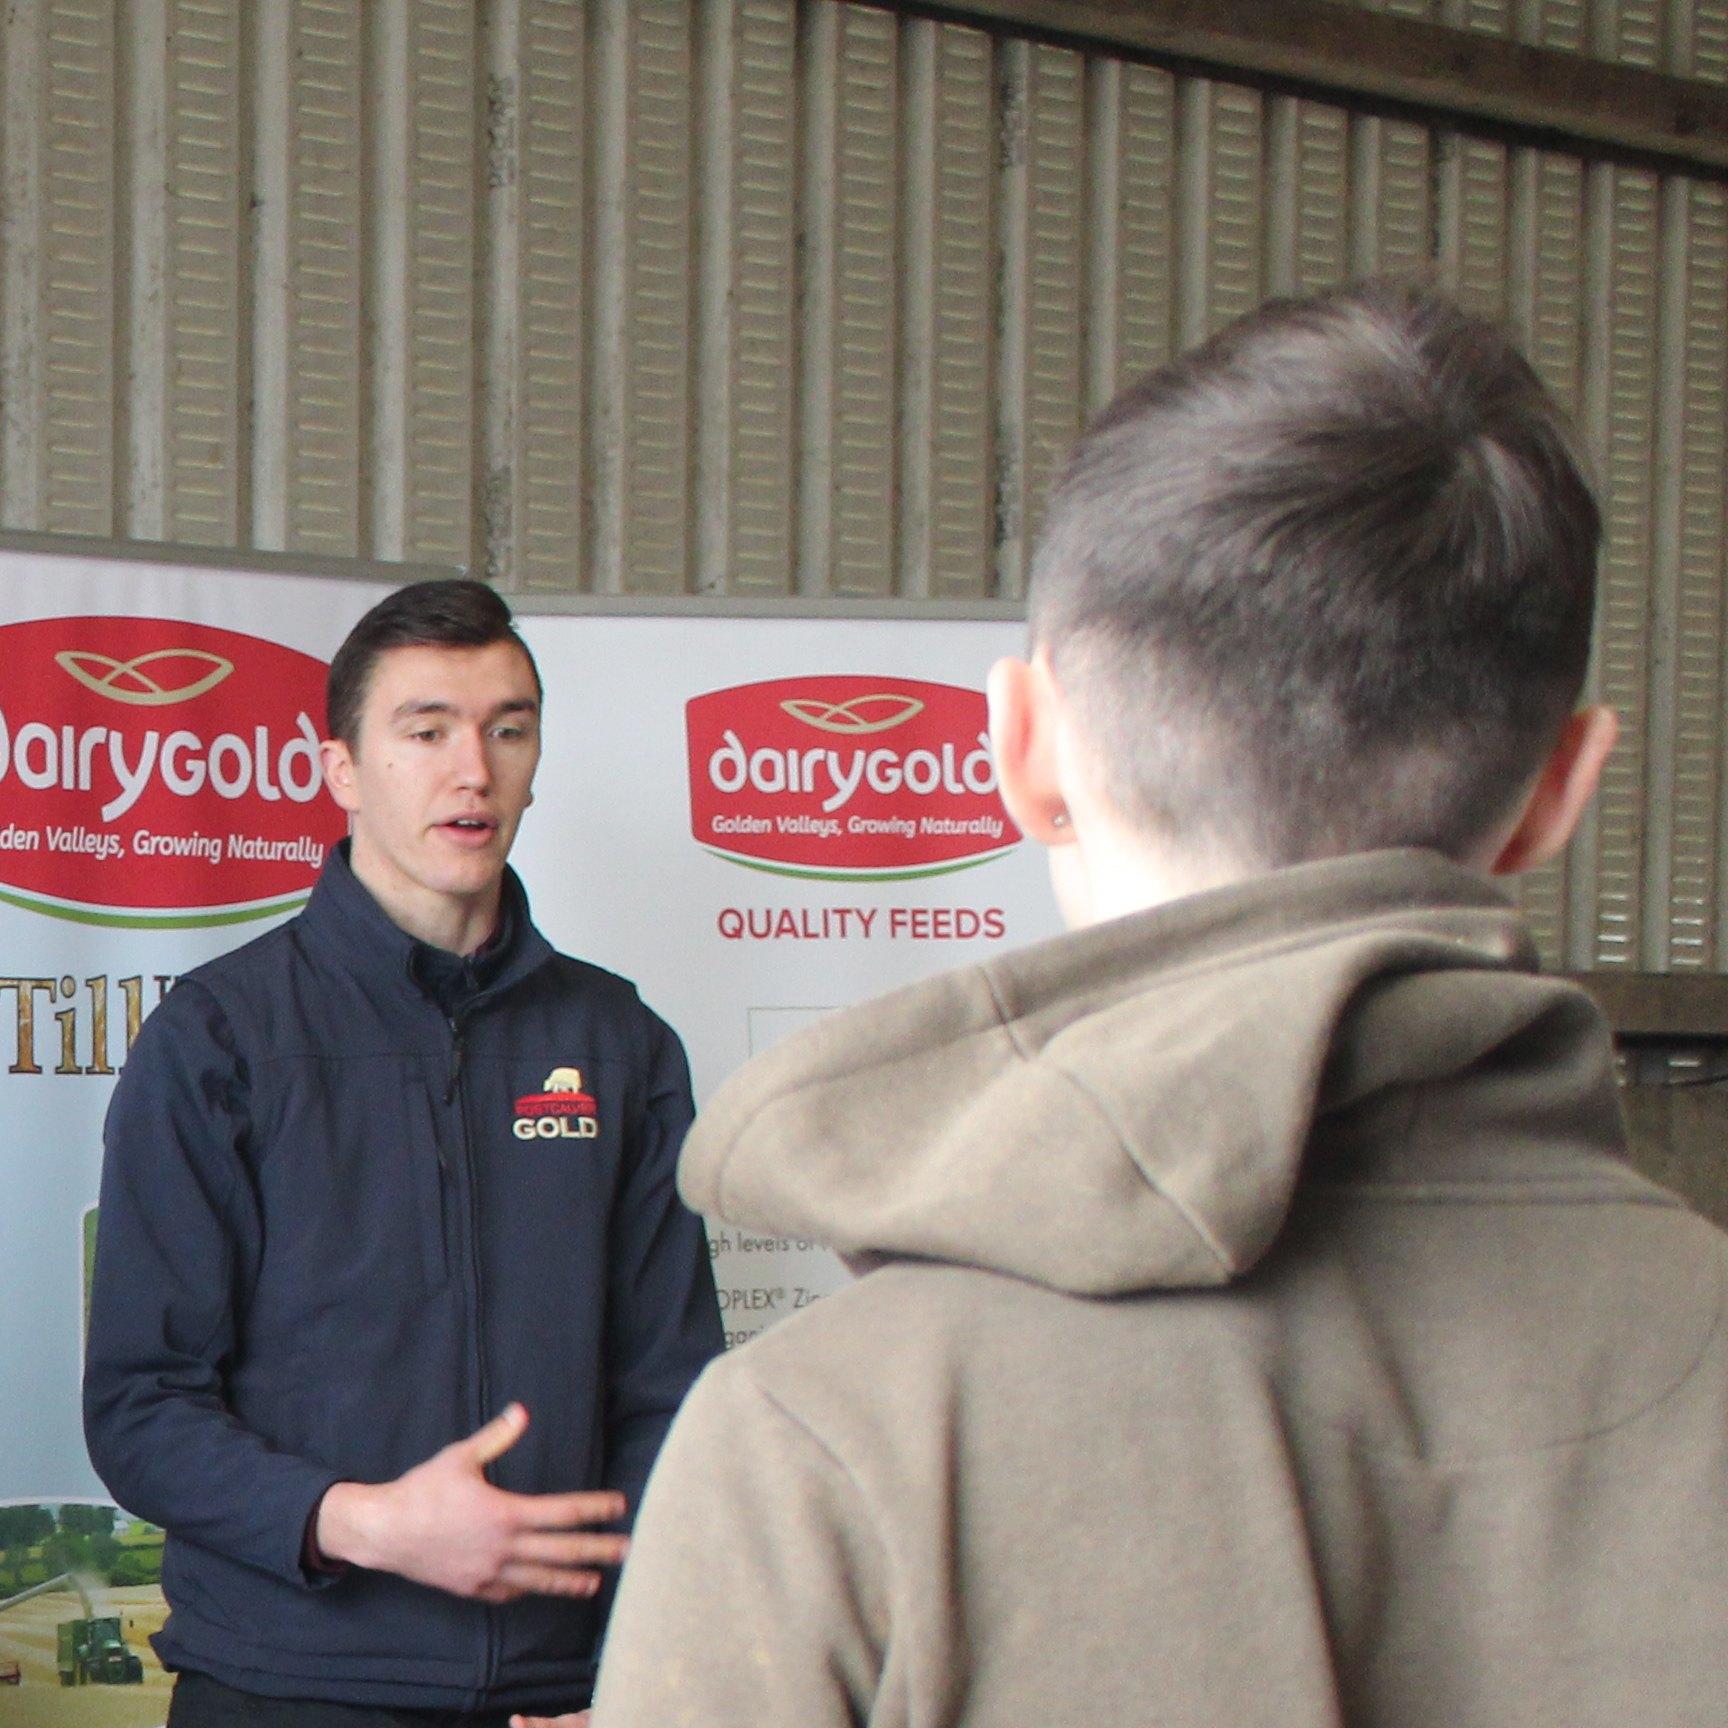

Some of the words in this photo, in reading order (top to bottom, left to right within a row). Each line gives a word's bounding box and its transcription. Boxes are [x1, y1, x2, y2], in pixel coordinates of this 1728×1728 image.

[711, 814, 772, 835] Golden
[776, 815, 843, 839] Valleys,
[847, 815, 917, 839] Growing
[920, 816, 1004, 839] Naturally
[46, 825, 126, 860] Valleys,
[132, 829, 222, 865] Growing
[226, 834, 325, 869] Naturally
[717, 907, 879, 940] QUALITY
[889, 907, 1007, 940] FEEDS
[512, 1115, 598, 1140] GOLD
[737, 1231, 791, 1252] levels
